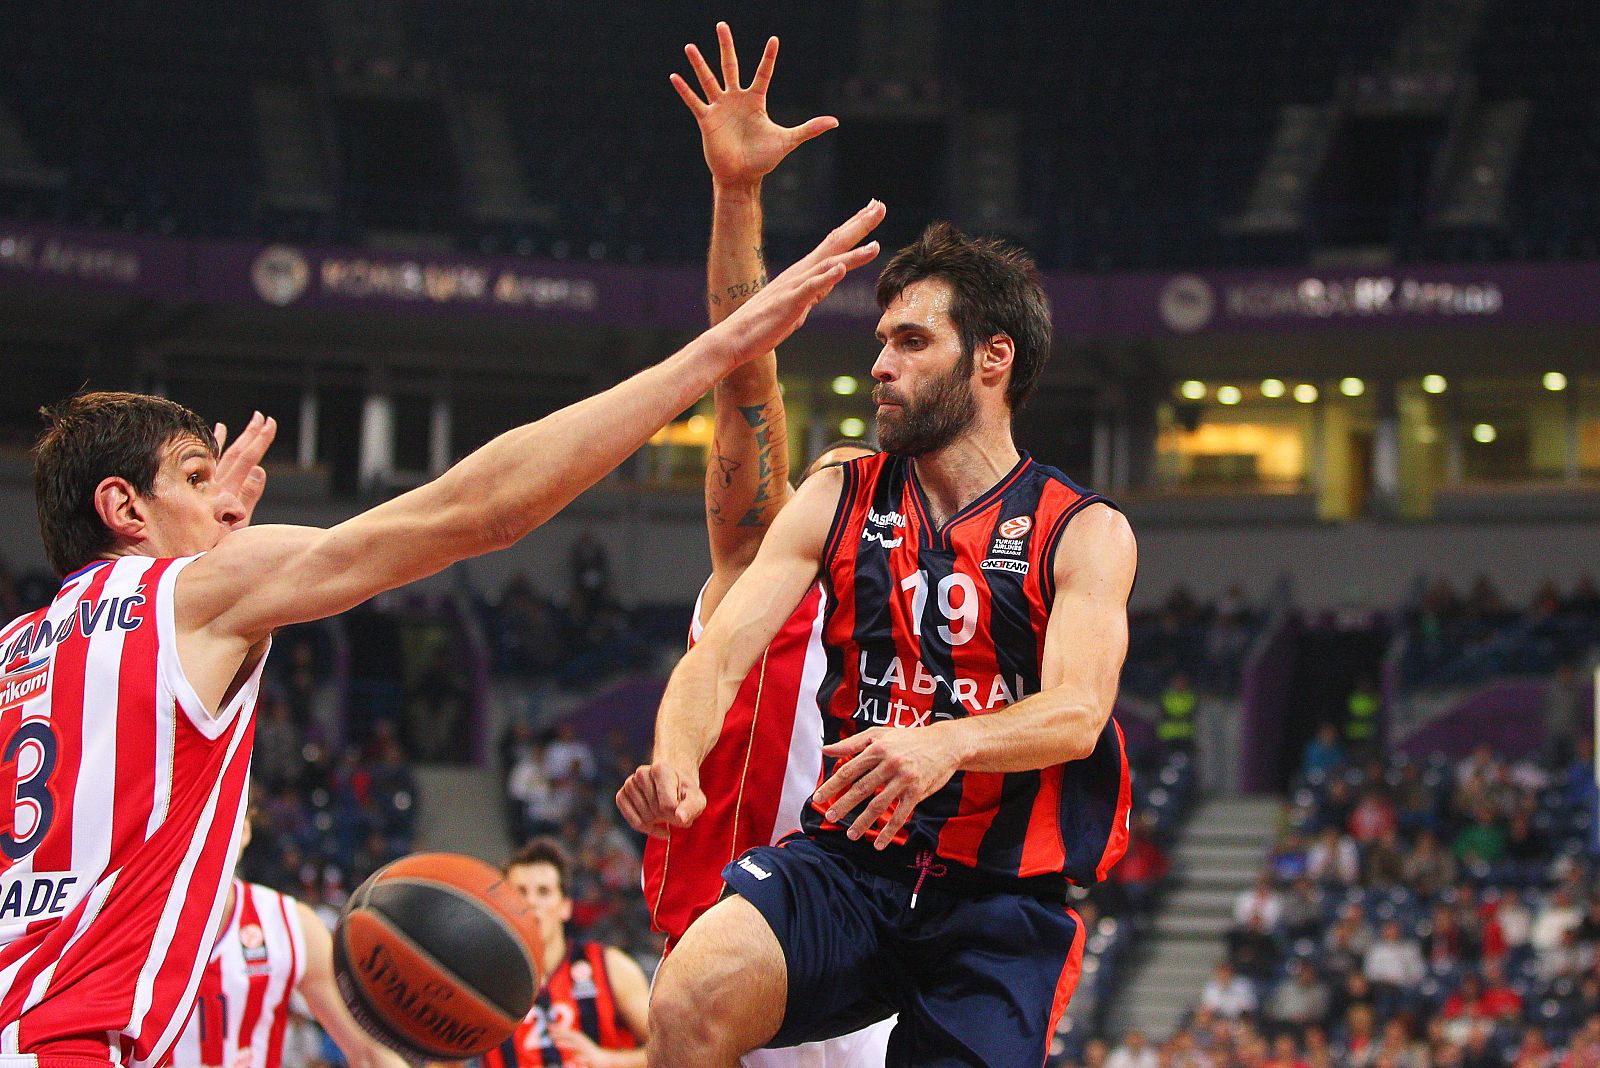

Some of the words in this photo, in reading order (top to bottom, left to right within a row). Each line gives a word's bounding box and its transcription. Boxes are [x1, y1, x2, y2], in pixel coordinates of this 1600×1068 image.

[901, 569, 979, 645] 19
[853, 690, 954, 728] kutx
[0, 877, 78, 919] ADE
[360, 944, 486, 1049] SPALDING
